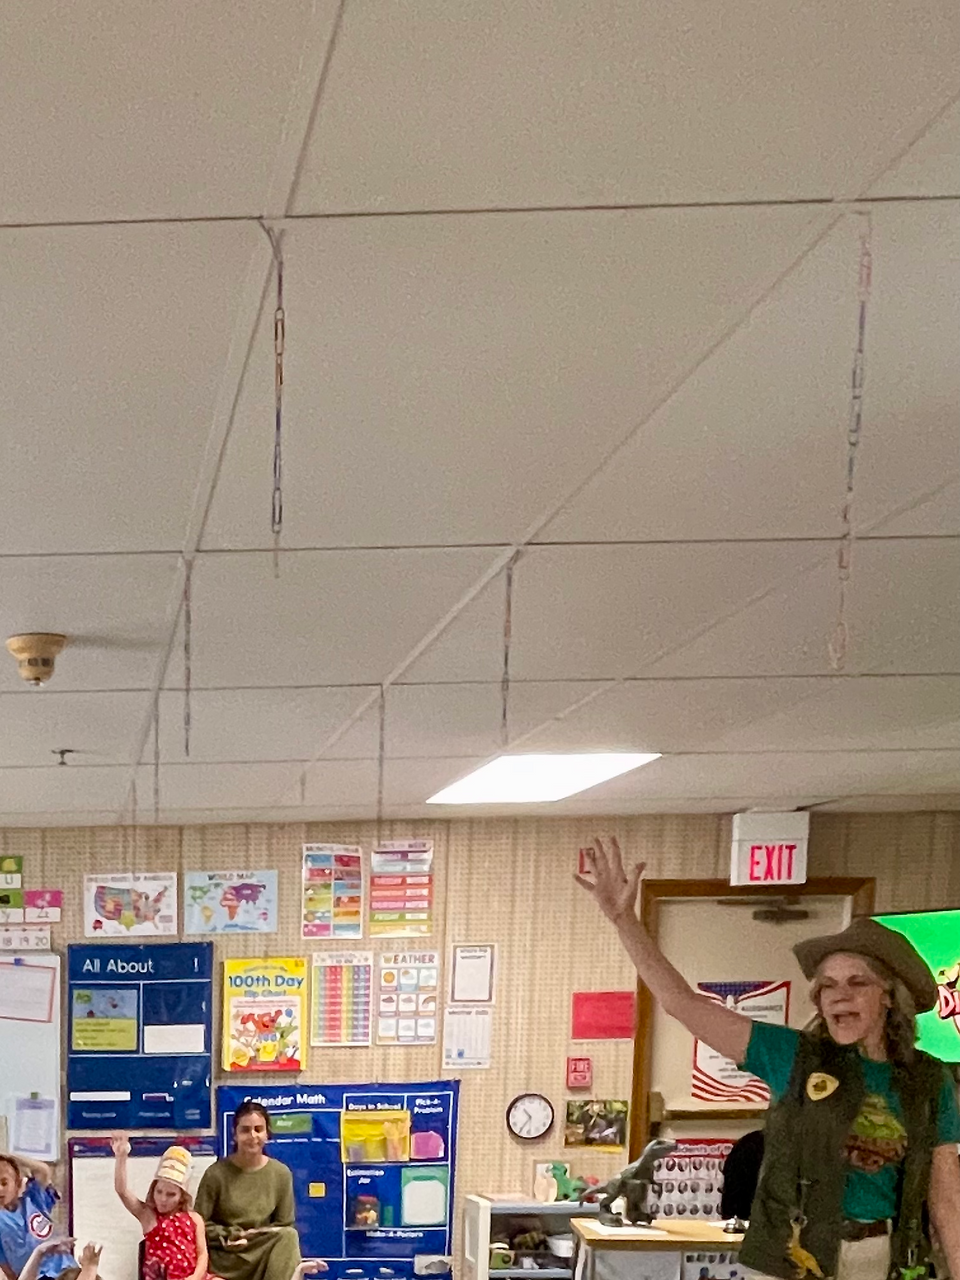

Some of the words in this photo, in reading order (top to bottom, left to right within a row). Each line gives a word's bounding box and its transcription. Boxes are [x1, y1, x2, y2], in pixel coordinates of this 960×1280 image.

[749, 843, 797, 882] EXIT
[3, 936, 13, 946] 18
[20, 936, 29, 946] 19
[35, 936, 48, 946] 20
[383, 954, 435, 964] WEATHER
[82, 958, 101, 973] All
[106, 958, 155, 974] About
[229, 975, 271, 988] 100th
[274, 975, 304, 989] Day
[296, 1093, 326, 1105] Math
[348, 1103, 366, 1111] Days
[376, 1102, 401, 1110] School
[414, 1106, 443, 1114] Problem
[347, 1169, 385, 1177] Estimation
